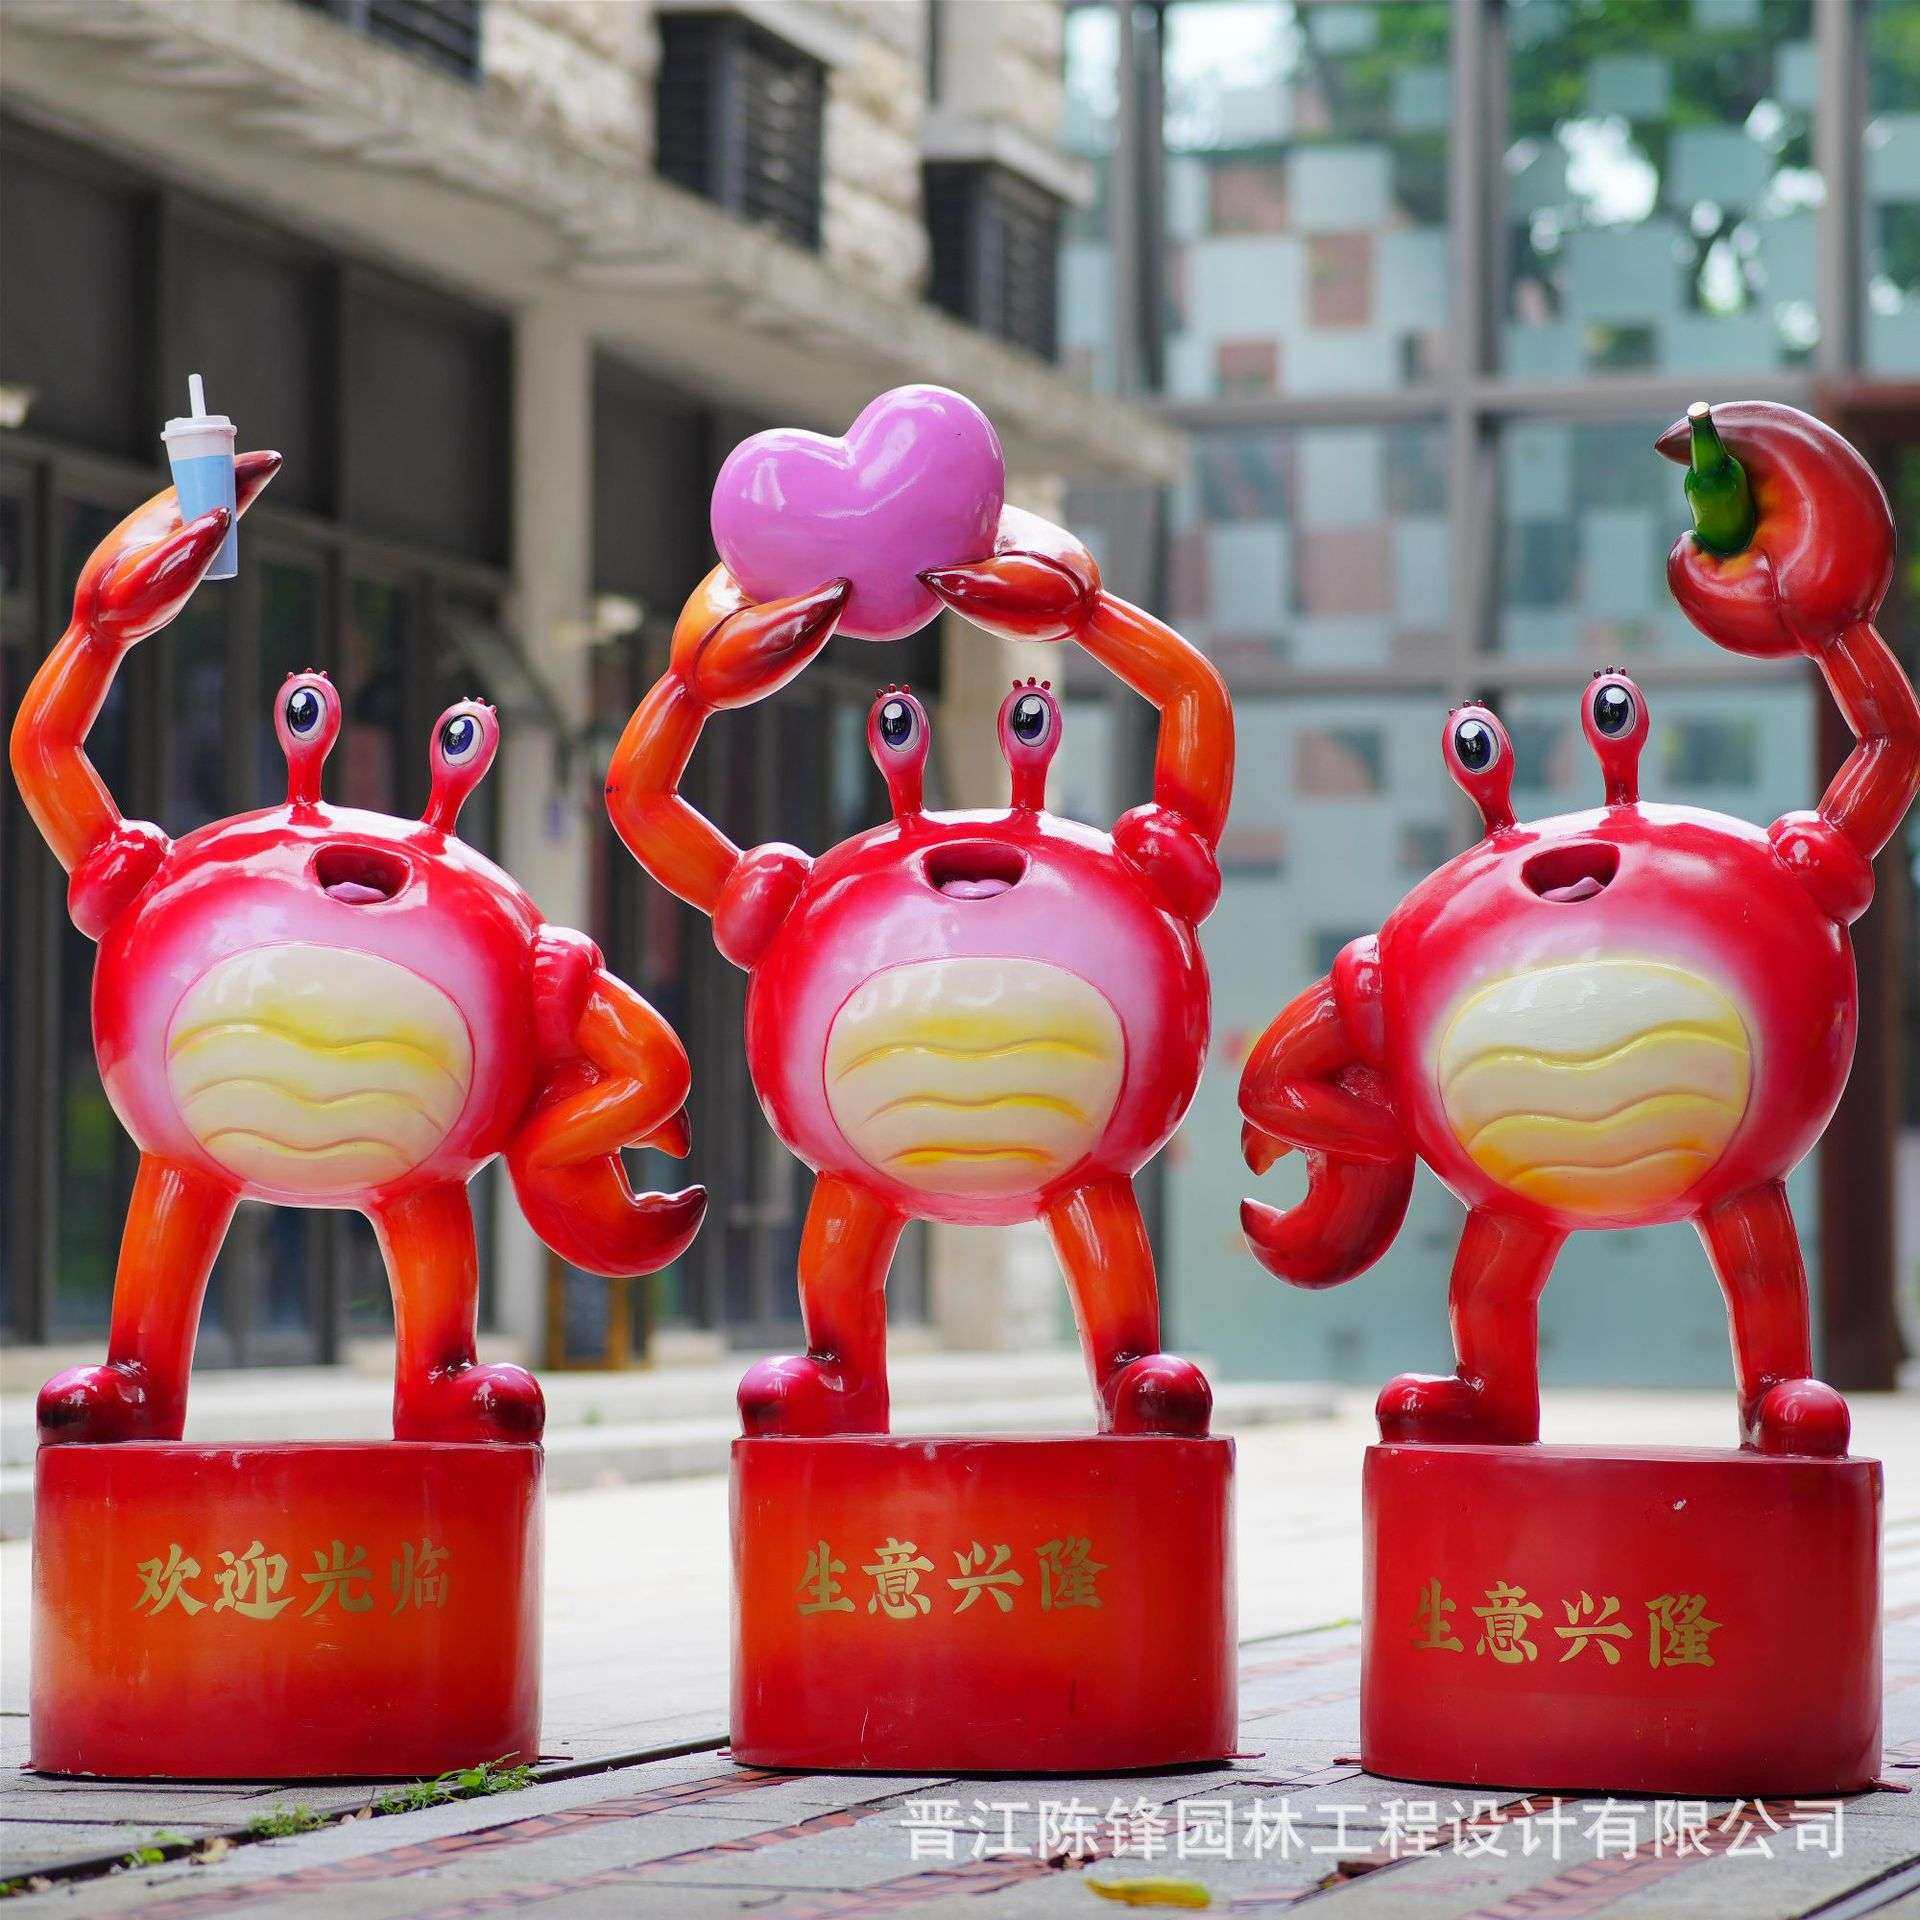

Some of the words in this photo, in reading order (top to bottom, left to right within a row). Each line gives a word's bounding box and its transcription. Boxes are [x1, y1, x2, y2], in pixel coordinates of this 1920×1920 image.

[133, 1537, 453, 1620] 欢迎光临
[795, 1535, 1111, 1619] 生意兴隆
[1410, 1577, 1724, 1669] 生意兴隆
